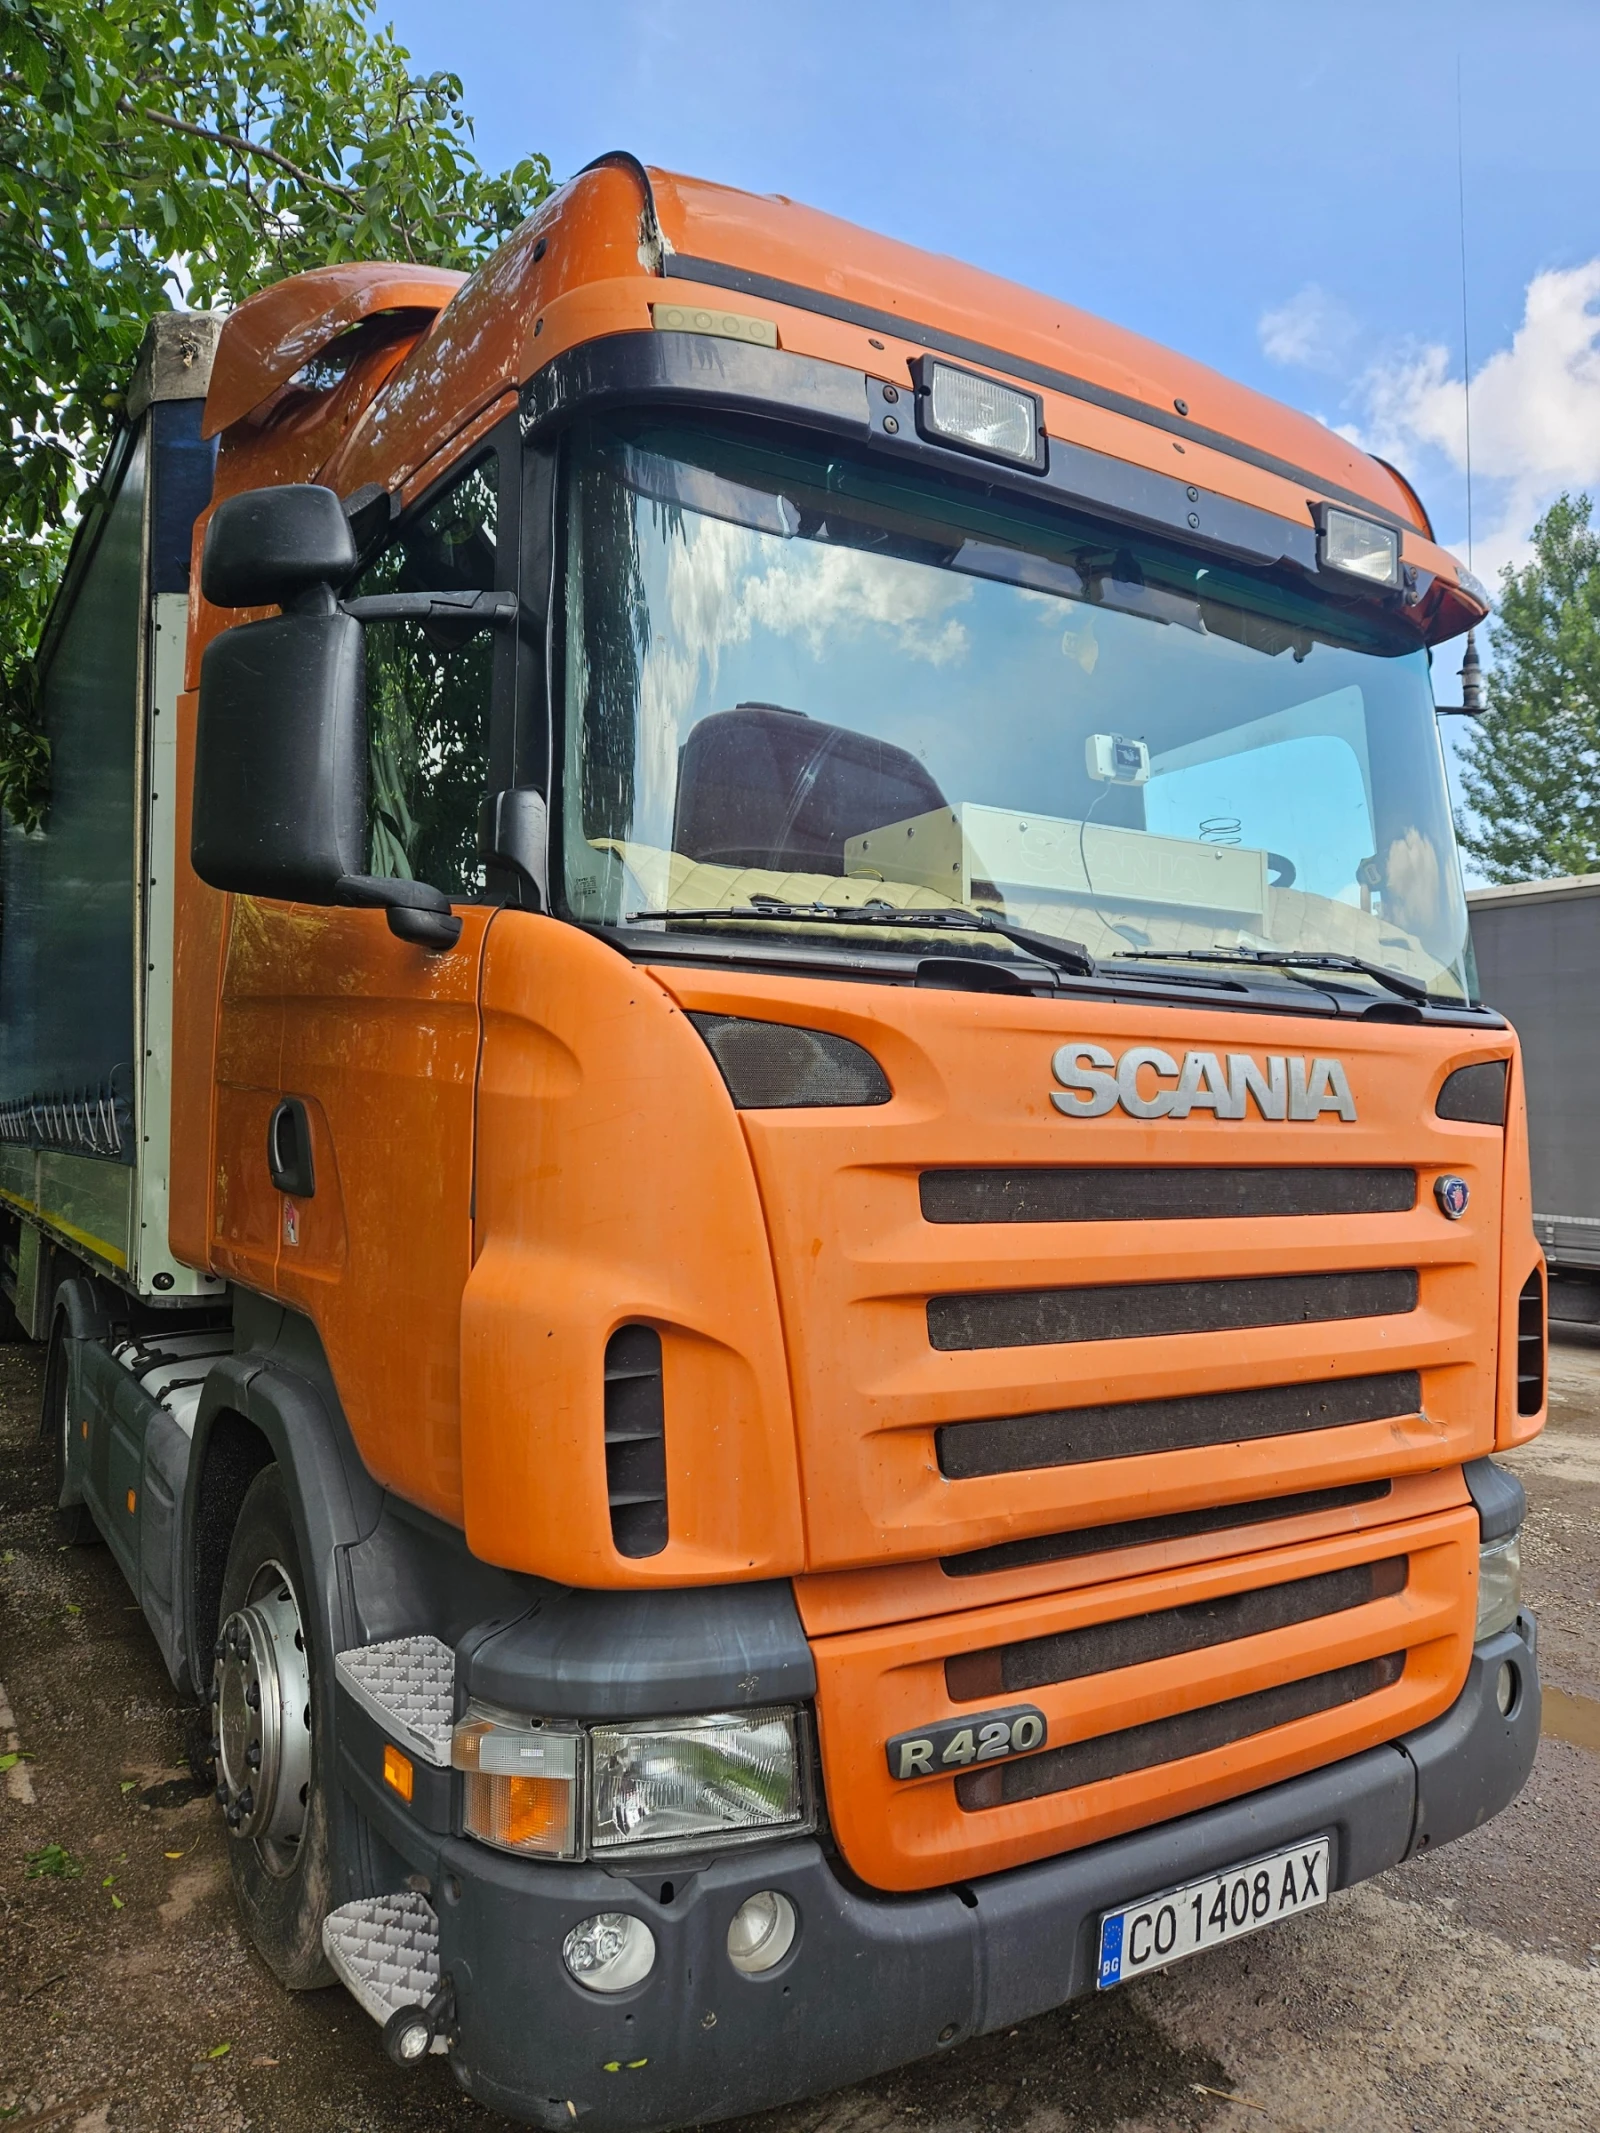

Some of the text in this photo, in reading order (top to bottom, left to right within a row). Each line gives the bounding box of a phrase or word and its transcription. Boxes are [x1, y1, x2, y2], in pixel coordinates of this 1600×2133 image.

[1020, 828, 1206, 898] SCANIA
[1049, 1042, 1357, 1122] SCANIA
[899, 1715, 1043, 1779] R 420
[1129, 1850, 1321, 1965] CO 1408 AX
[1102, 1956, 1119, 1977] BG
